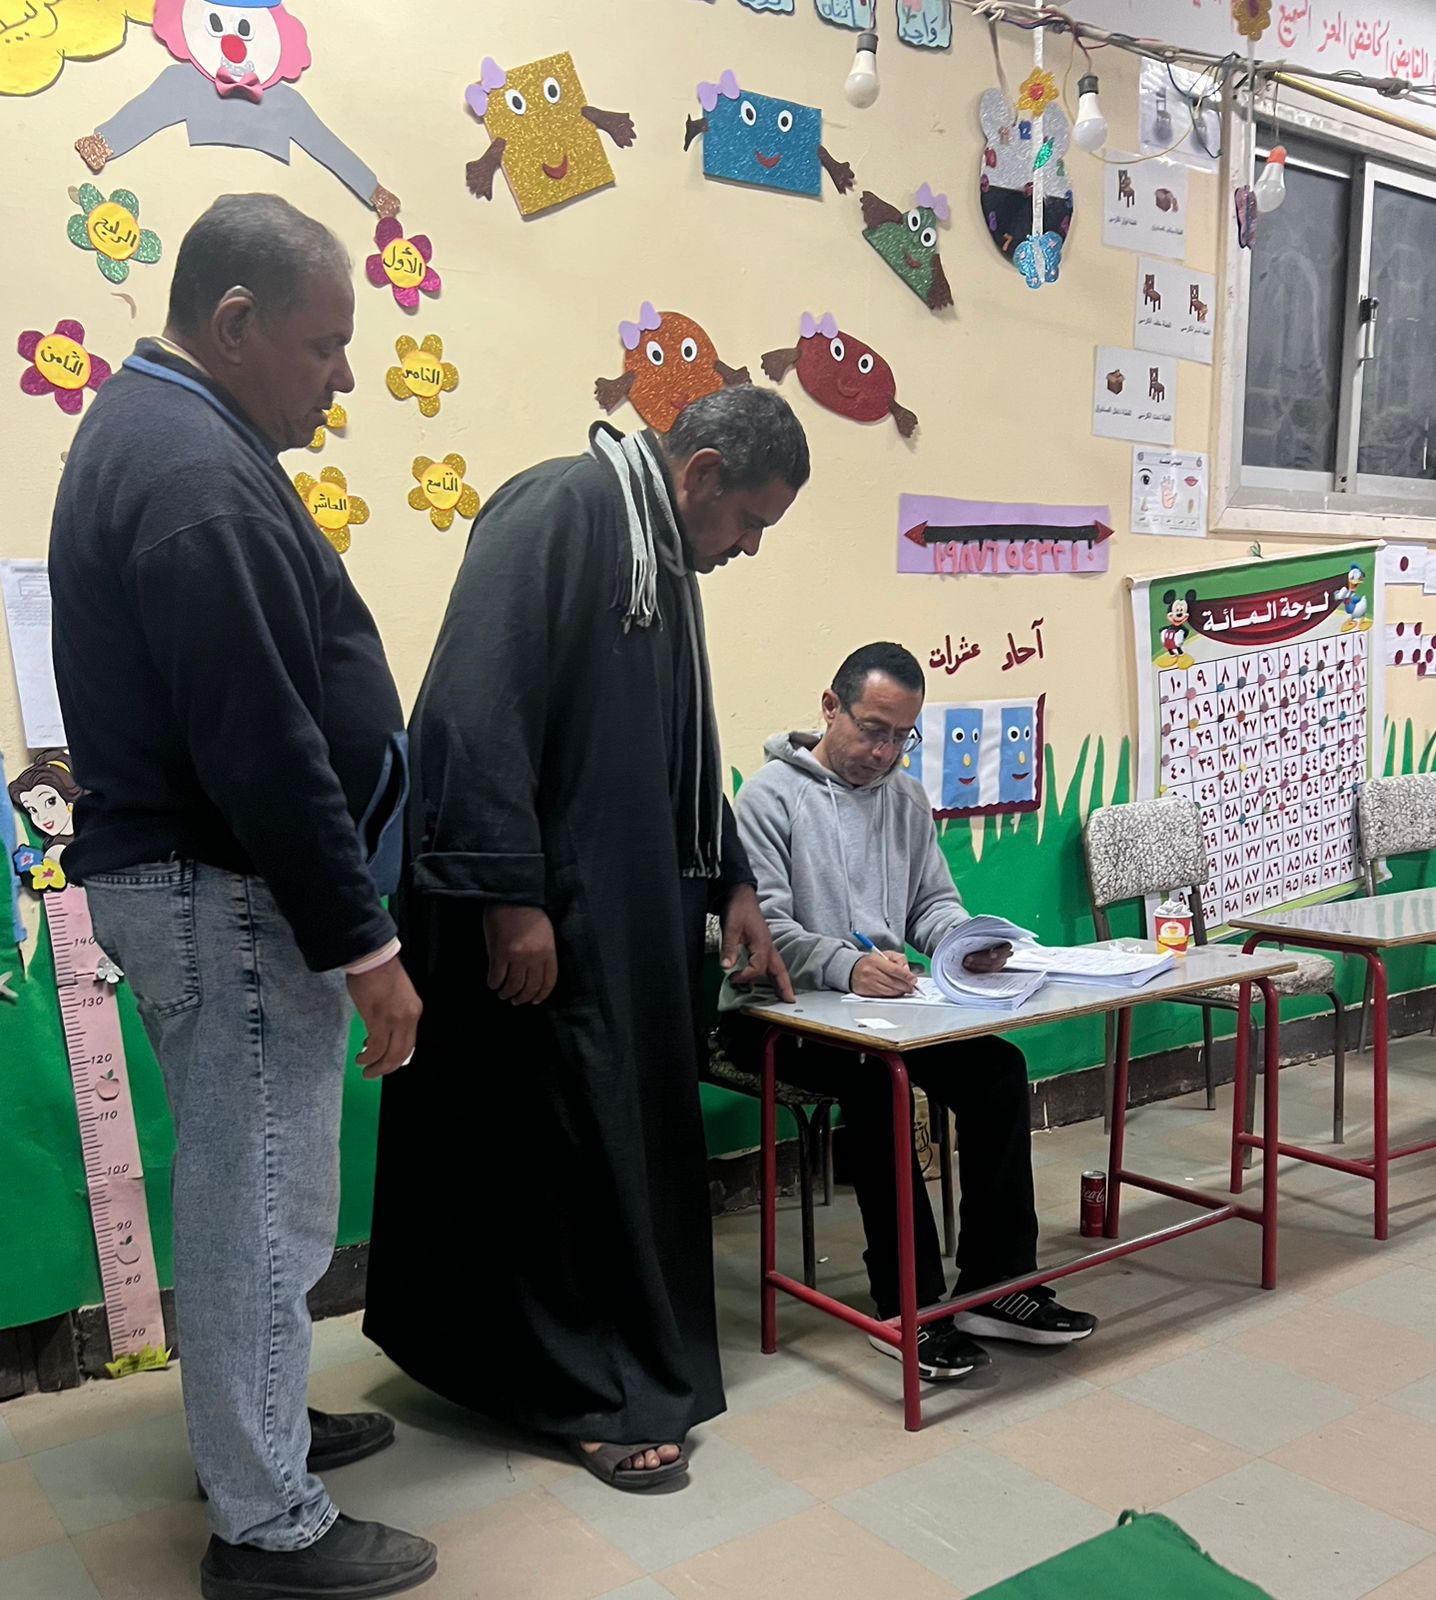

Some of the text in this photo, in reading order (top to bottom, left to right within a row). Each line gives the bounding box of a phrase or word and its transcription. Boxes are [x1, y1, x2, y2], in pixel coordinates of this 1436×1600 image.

[93, 217, 138, 248] الرابع
[1003, 232, 1014, 252] 7
[40, 345, 84, 377] الثامن
[426, 471, 459, 495] التاسع
[311, 492, 348, 515] العاشر
[929, 617, 1044, 675] آحاد عشرات
[1170, 638, 1364, 694] ١ ٢ ٣ ٤ ٥ ٦ ٧ ٨ ٩ ١٠
[1355, 666, 1365, 682] ١١
[1283, 681, 1297, 699] ١٥
[1303, 676, 1316, 695] ١٤
[1241, 690, 1256, 709] ١٧
[1262, 686, 1276, 704] ١٦
[1194, 700, 1213, 720] ١٩
[1221, 696, 1236, 714] ١٨
[1304, 704, 1316, 720] ٢٤
[1170, 707, 1184, 724] ٢٠
[1264, 714, 1277, 730] ٢٦
[1284, 709, 1298, 725] ٢٥
[1243, 718, 1257, 736] ٢٧
[1284, 735, 1298, 751] ٣٥
[1355, 742, 1365, 758] ٤١
[1243, 744, 1258, 762] ٣٧
[1325, 751, 1336, 767] ٤٣
[1171, 763, 1186, 780] ٤٠
[1198, 756, 1215, 773] ٣٩
[1284, 761, 1298, 778] ٤٥
[1306, 755, 1318, 772] ٤٤
[1244, 771, 1258, 789] ٤٧
[1264, 766, 1278, 783] ٤٦
[1354, 765, 1364, 781] ٥١
[1201, 783, 1216, 800] ٤٩
[1223, 777, 1238, 795] ٤٨
[1306, 779, 1319, 796] ٥٤
[1324, 775, 1336, 791] ٥٣
[1265, 791, 1279, 807] ٥٦
[1285, 785, 1299, 802] ٥٥
[1224, 803, 1239, 820] ٥٨
[1245, 795, 1259, 814] ٥٧
[1305, 803, 1319, 818] ٦٤
[1324, 798, 1336, 813] ٦٣
[1202, 808, 1217, 826] ٥٩
[1266, 814, 1280, 830] ٦٦
[1285, 808, 1299, 824] ٦٥
[1224, 826, 1239, 843] ٦٨
[1244, 819, 1259, 836] ٦٧
[1305, 827, 1318, 843] ٧٤
[1204, 832, 1218, 849] ٦٩
[1266, 839, 1280, 855] ٧٦
[1286, 832, 1300, 849] ٧٥
[1224, 852, 1239, 868] ٧٨
[1245, 844, 1260, 861] ٧٧
[1305, 849, 1318, 866] ٨٤
[1324, 844, 1337, 861] ٨٣
[1266, 862, 1280, 879] ٨٦
[1287, 855, 1301, 872] ٨٥
[1245, 868, 1259, 886] ٨٧
[1304, 871, 1317, 886] ٩٤
[1323, 866, 1337, 880] ٩٣
[1202, 881, 1217, 899] ٨٩
[1225, 875, 1240, 892] ٨٨
[1266, 885, 1279, 899] ٩٦
[1286, 878, 1299, 892] ٩٥
[1225, 899, 1239, 913] ٩٨
[1245, 890, 1259, 906] ٩٧
[75, 936, 96, 947] 140
[82, 996, 104, 1008] 130
[91, 1053, 113, 1064] 120
[99, 1110, 118, 1120] 110
[107, 1163, 129, 1175] 100
[116, 1220, 133, 1230] 90
[125, 1274, 141, 1285] 80
[129, 1327, 146, 1338] 70
